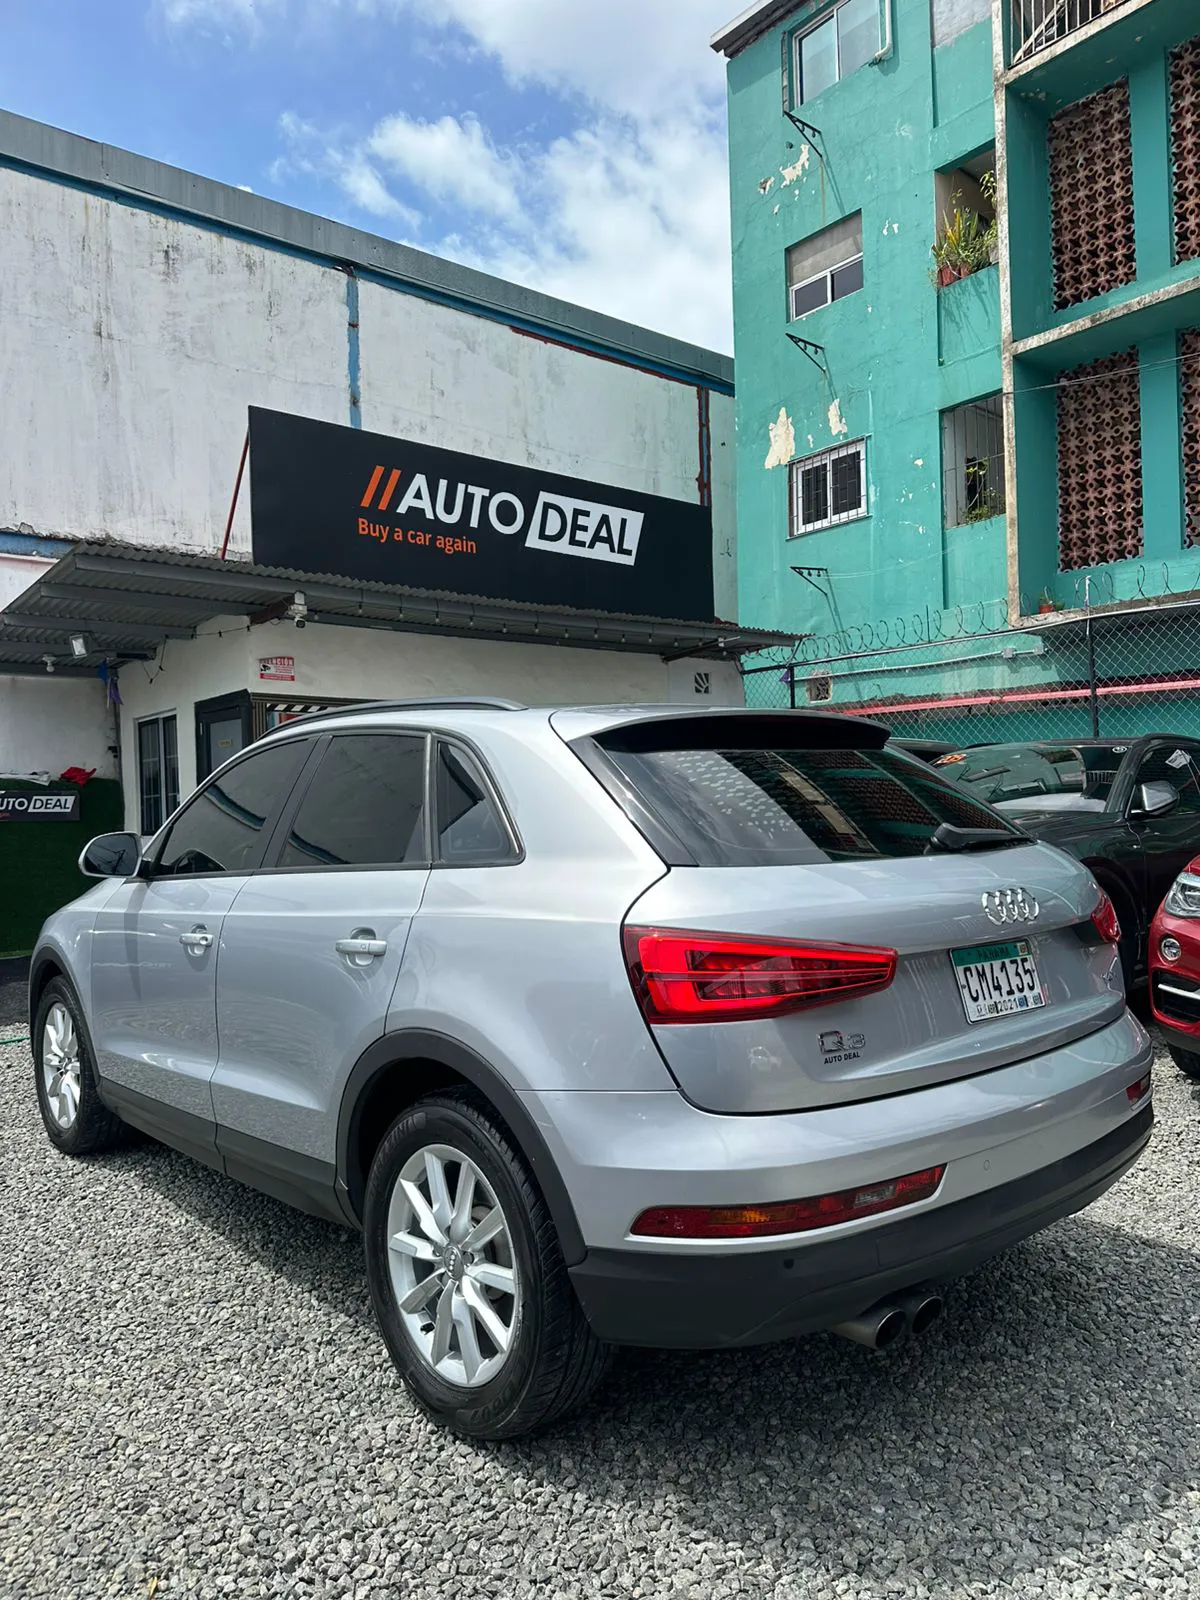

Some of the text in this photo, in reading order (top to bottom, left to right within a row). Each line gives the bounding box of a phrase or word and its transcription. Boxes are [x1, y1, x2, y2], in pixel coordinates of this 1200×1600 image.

[396, 473, 634, 557] AUTO DEAL
[357, 517, 477, 554] Buy a car again
[0, 797, 71, 811] UTO DEAL
[963, 957, 1035, 1003] CM4135
[824, 1051, 861, 1065] AUTO DEAL
